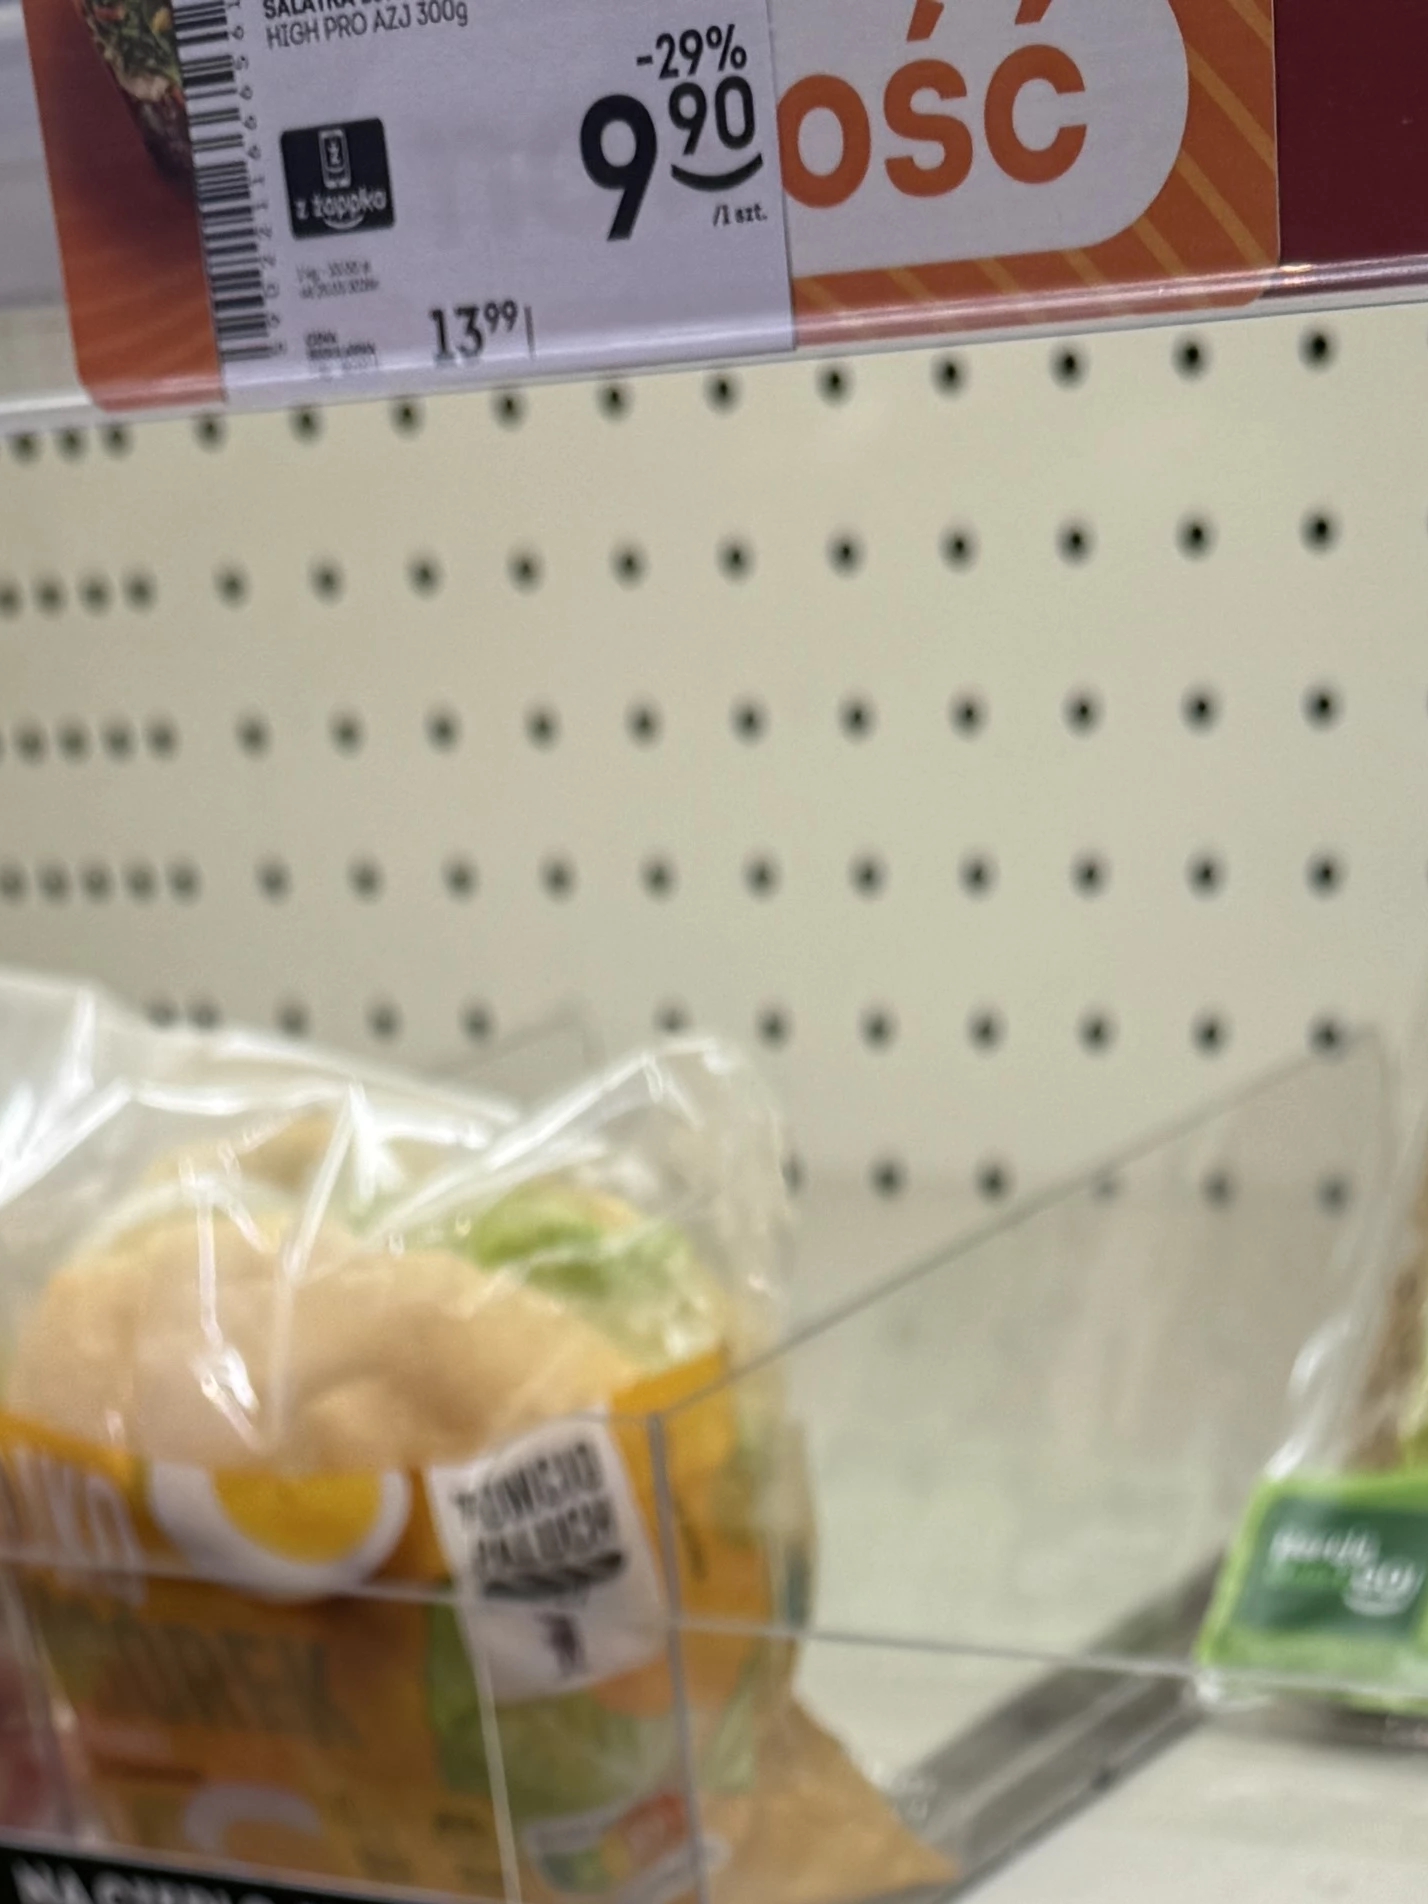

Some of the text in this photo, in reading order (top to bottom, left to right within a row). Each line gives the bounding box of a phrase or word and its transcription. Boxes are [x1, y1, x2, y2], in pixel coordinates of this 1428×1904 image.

[266, 19, 321, 49] HIGH
[324, 13, 368, 42] PRO
[417, 3, 469, 27] 300g
[636, 24, 748, 80] -29%
